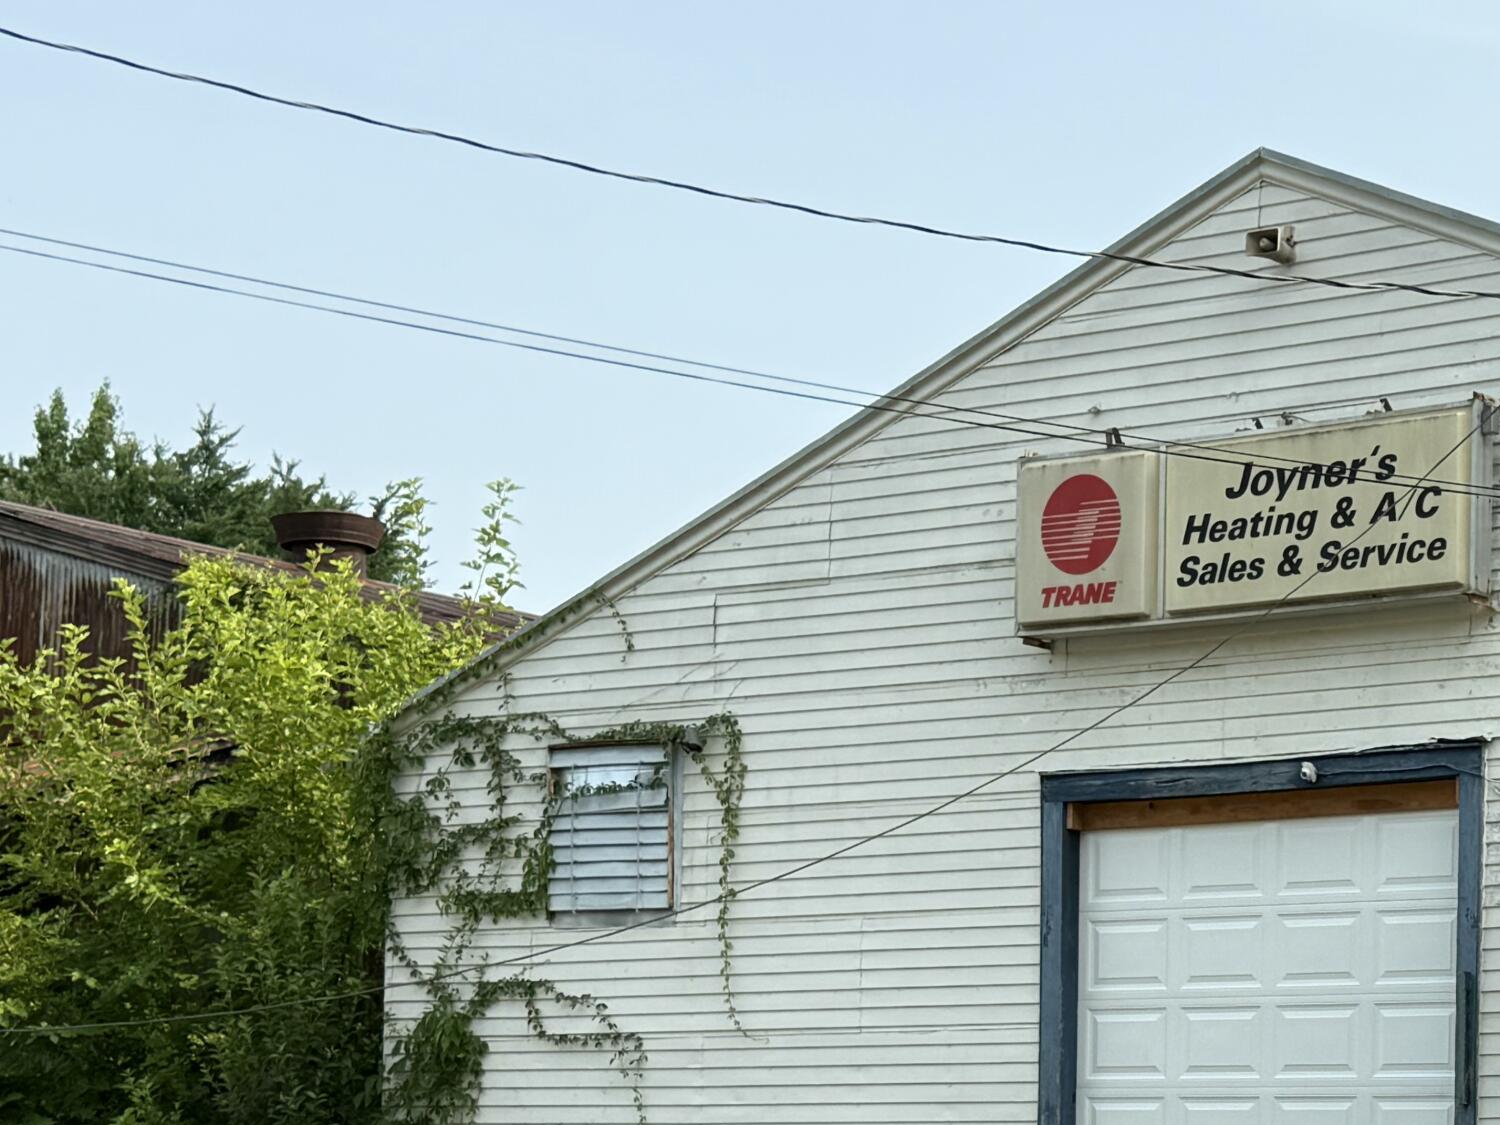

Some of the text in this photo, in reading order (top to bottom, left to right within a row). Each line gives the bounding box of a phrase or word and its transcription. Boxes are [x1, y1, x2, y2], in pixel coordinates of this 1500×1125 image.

[1225, 445, 1397, 502] Joyner's
[1182, 485, 1442, 546] Heating & A/C
[1177, 536, 1447, 587] Sales & Service
[1041, 581, 1117, 608] TRANE
